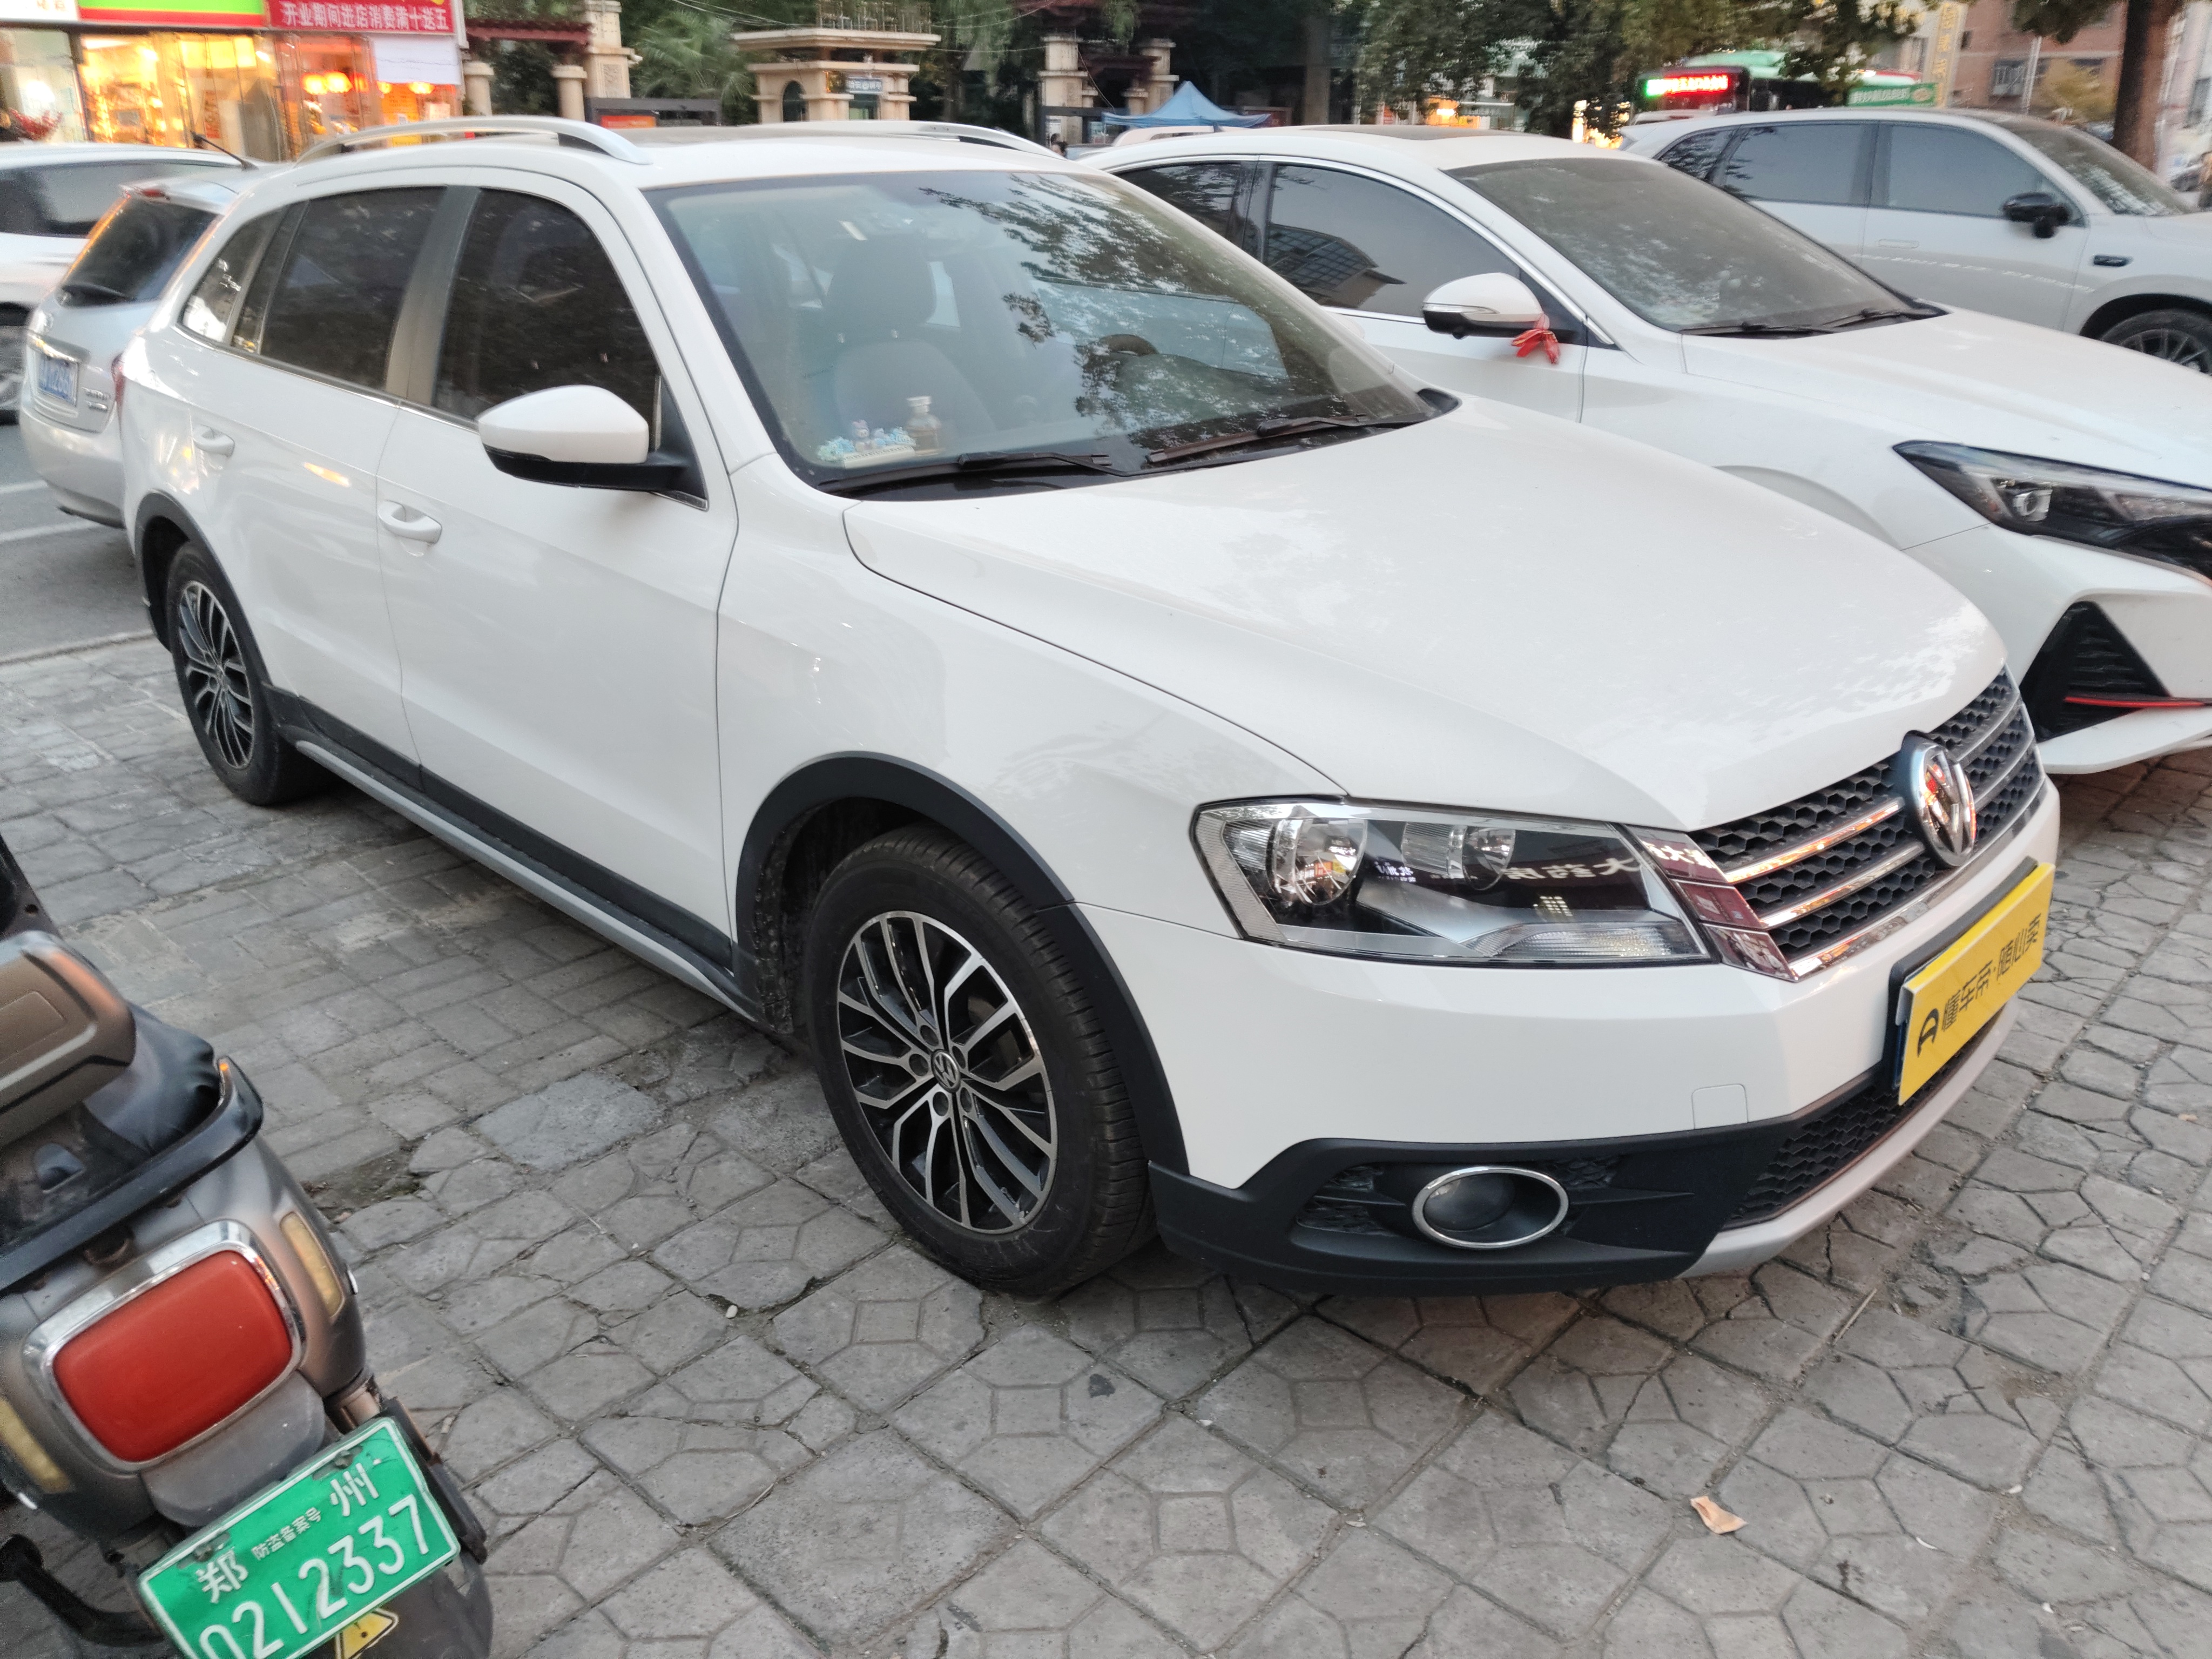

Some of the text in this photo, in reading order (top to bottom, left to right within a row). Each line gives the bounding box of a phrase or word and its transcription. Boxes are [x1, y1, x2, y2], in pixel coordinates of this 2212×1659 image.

[280, 1, 449, 30] 开业期间进店消费满十送五
[196, 1462, 379, 1603] 郑 防盗备案号 州
